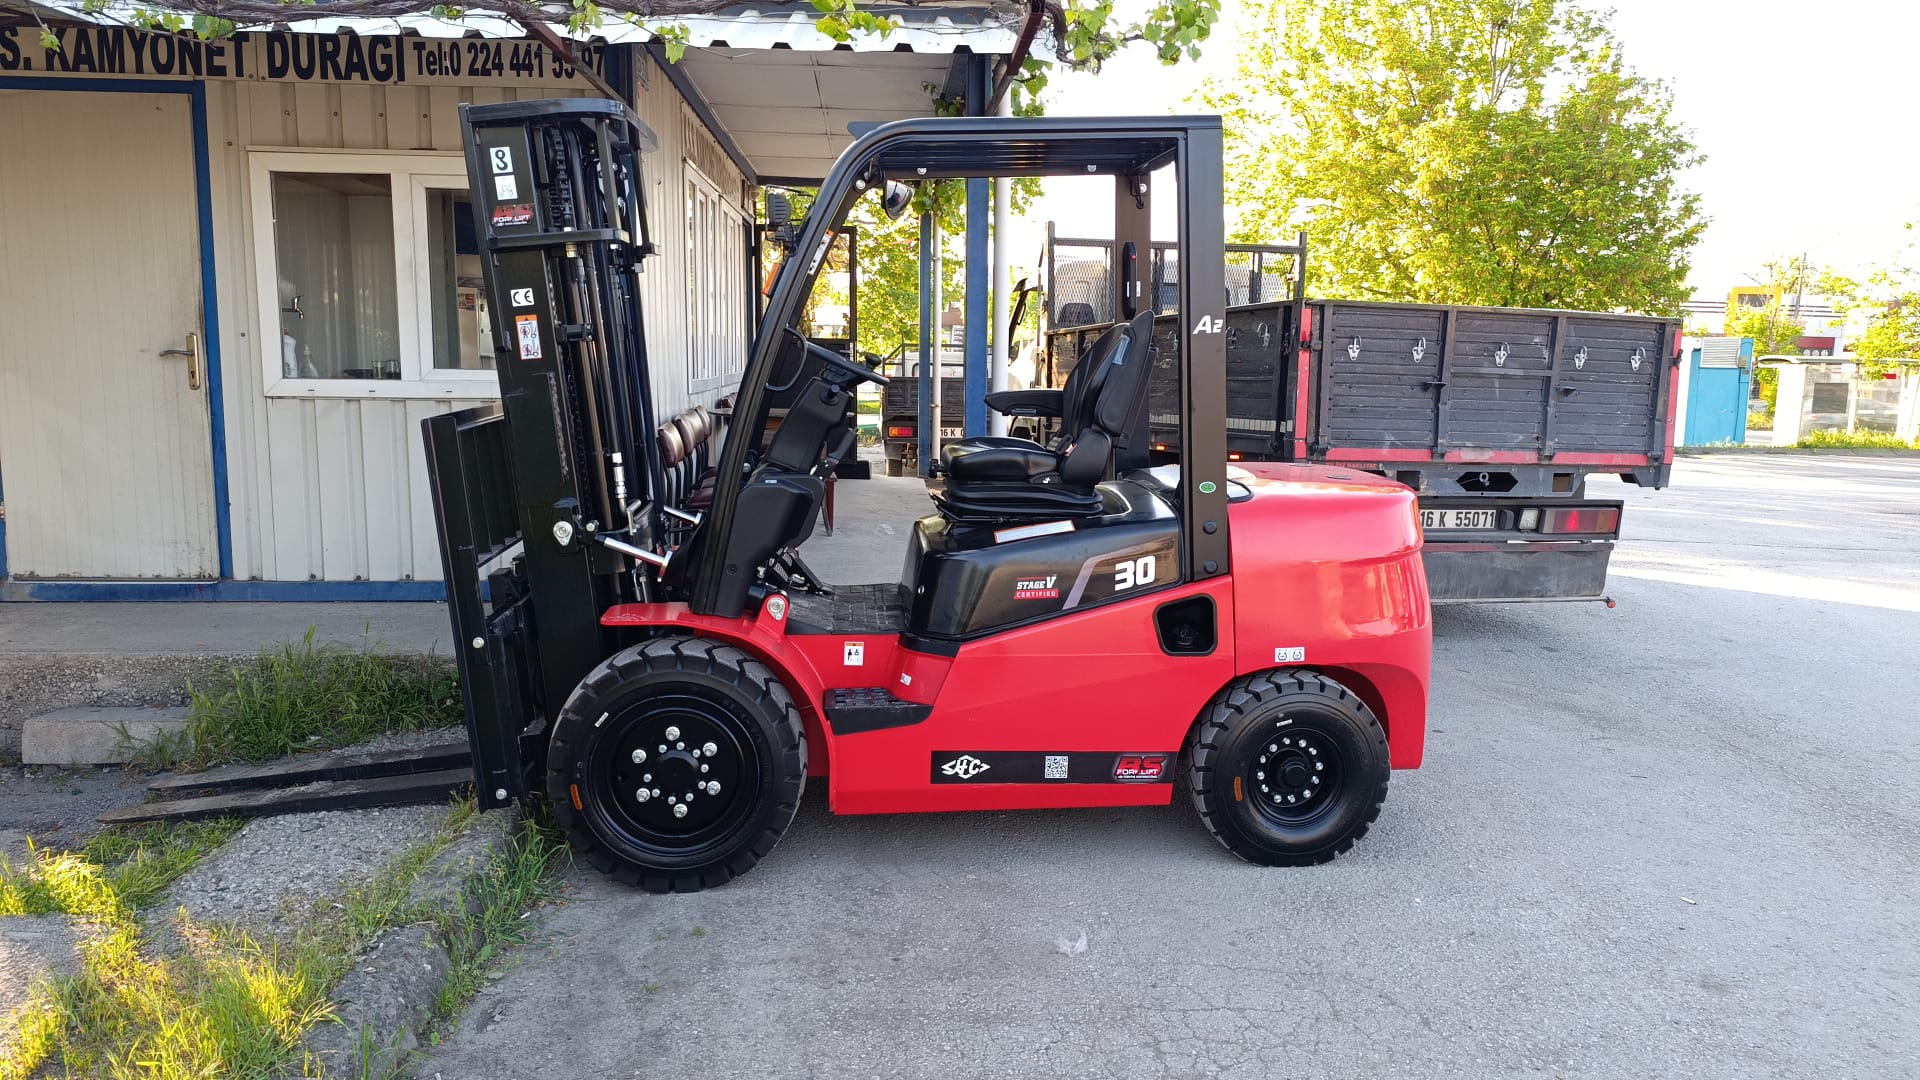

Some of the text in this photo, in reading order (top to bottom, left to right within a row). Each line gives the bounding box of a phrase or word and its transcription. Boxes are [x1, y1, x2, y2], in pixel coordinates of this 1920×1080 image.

[467, 42, 504, 77] 224
[510, 43, 543, 78] 441
[1192, 314, 1224, 335] A2
[1420, 511, 1495, 527] 16 K 55071
[1114, 555, 1156, 592] 30
[1016, 580, 1046, 590] STAGE
[1016, 590, 1056, 598] CERTIFIED
